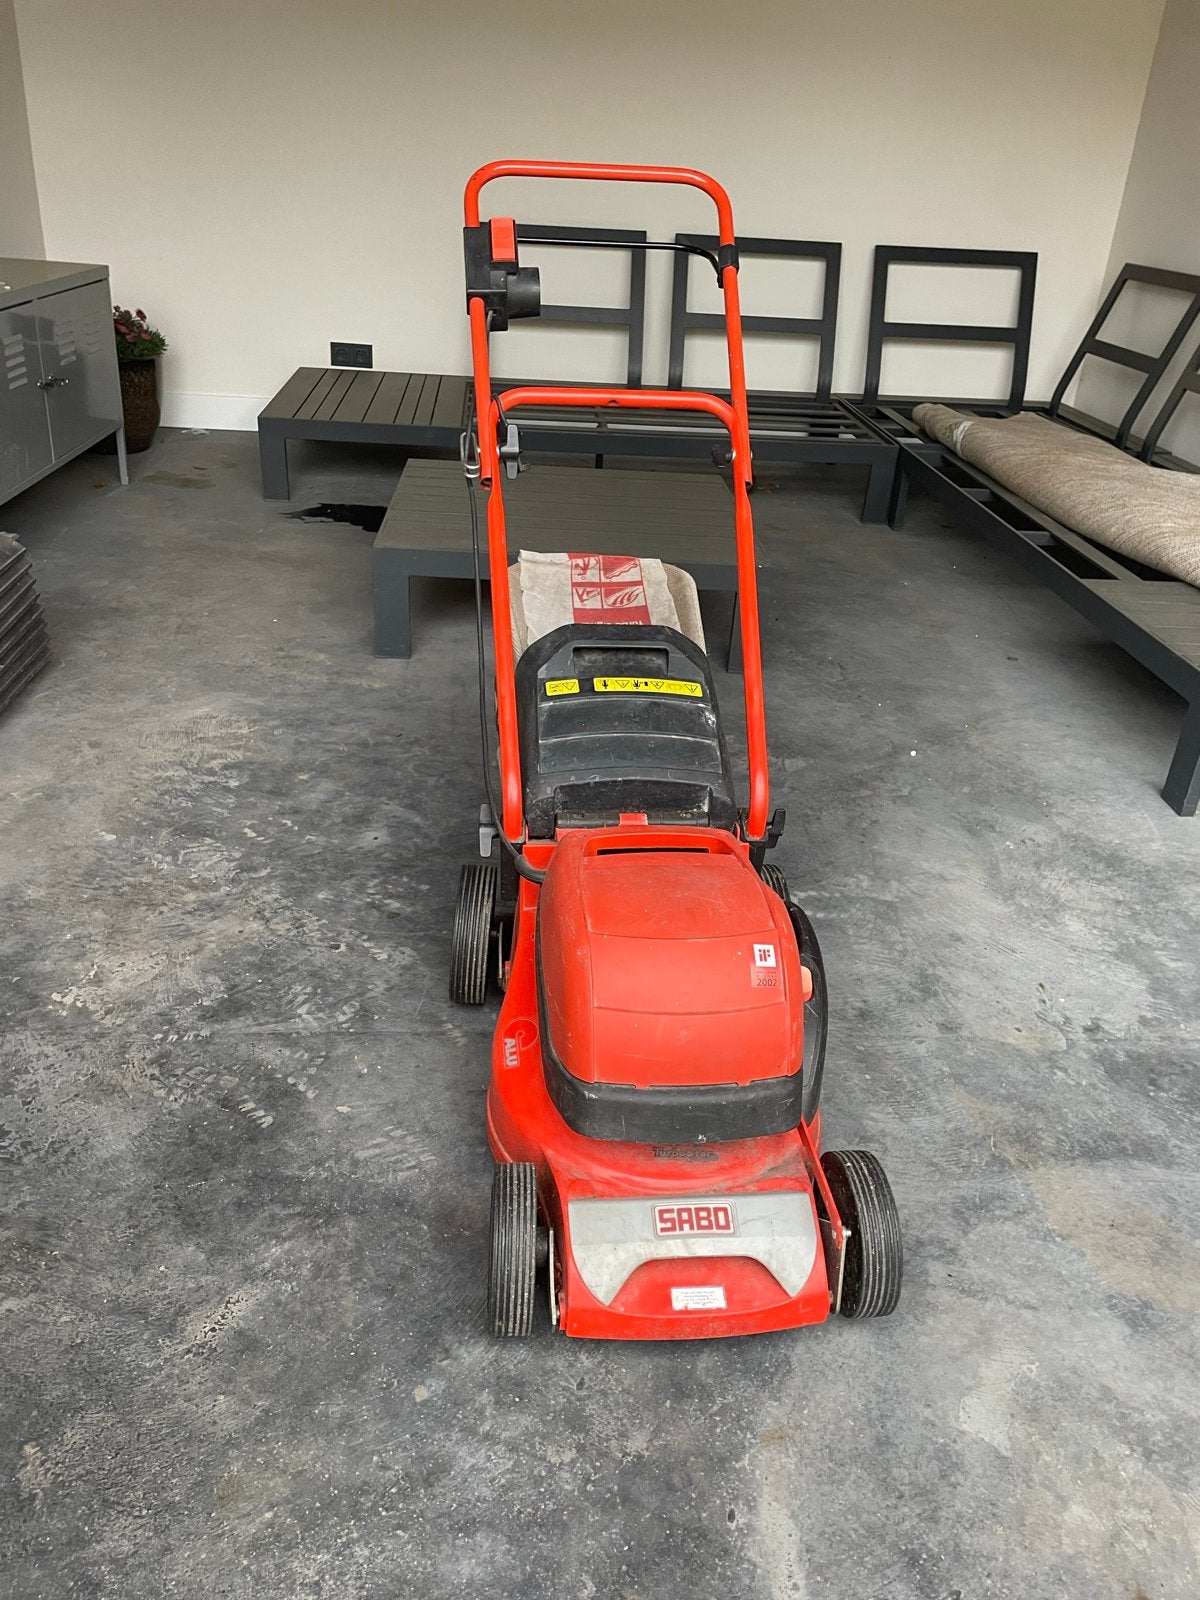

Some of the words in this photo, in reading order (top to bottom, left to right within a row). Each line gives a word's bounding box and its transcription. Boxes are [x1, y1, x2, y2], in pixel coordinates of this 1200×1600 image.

[756, 978, 777, 987] 2002
[504, 1038, 519, 1067] ALU
[658, 1206, 731, 1233] SABO
